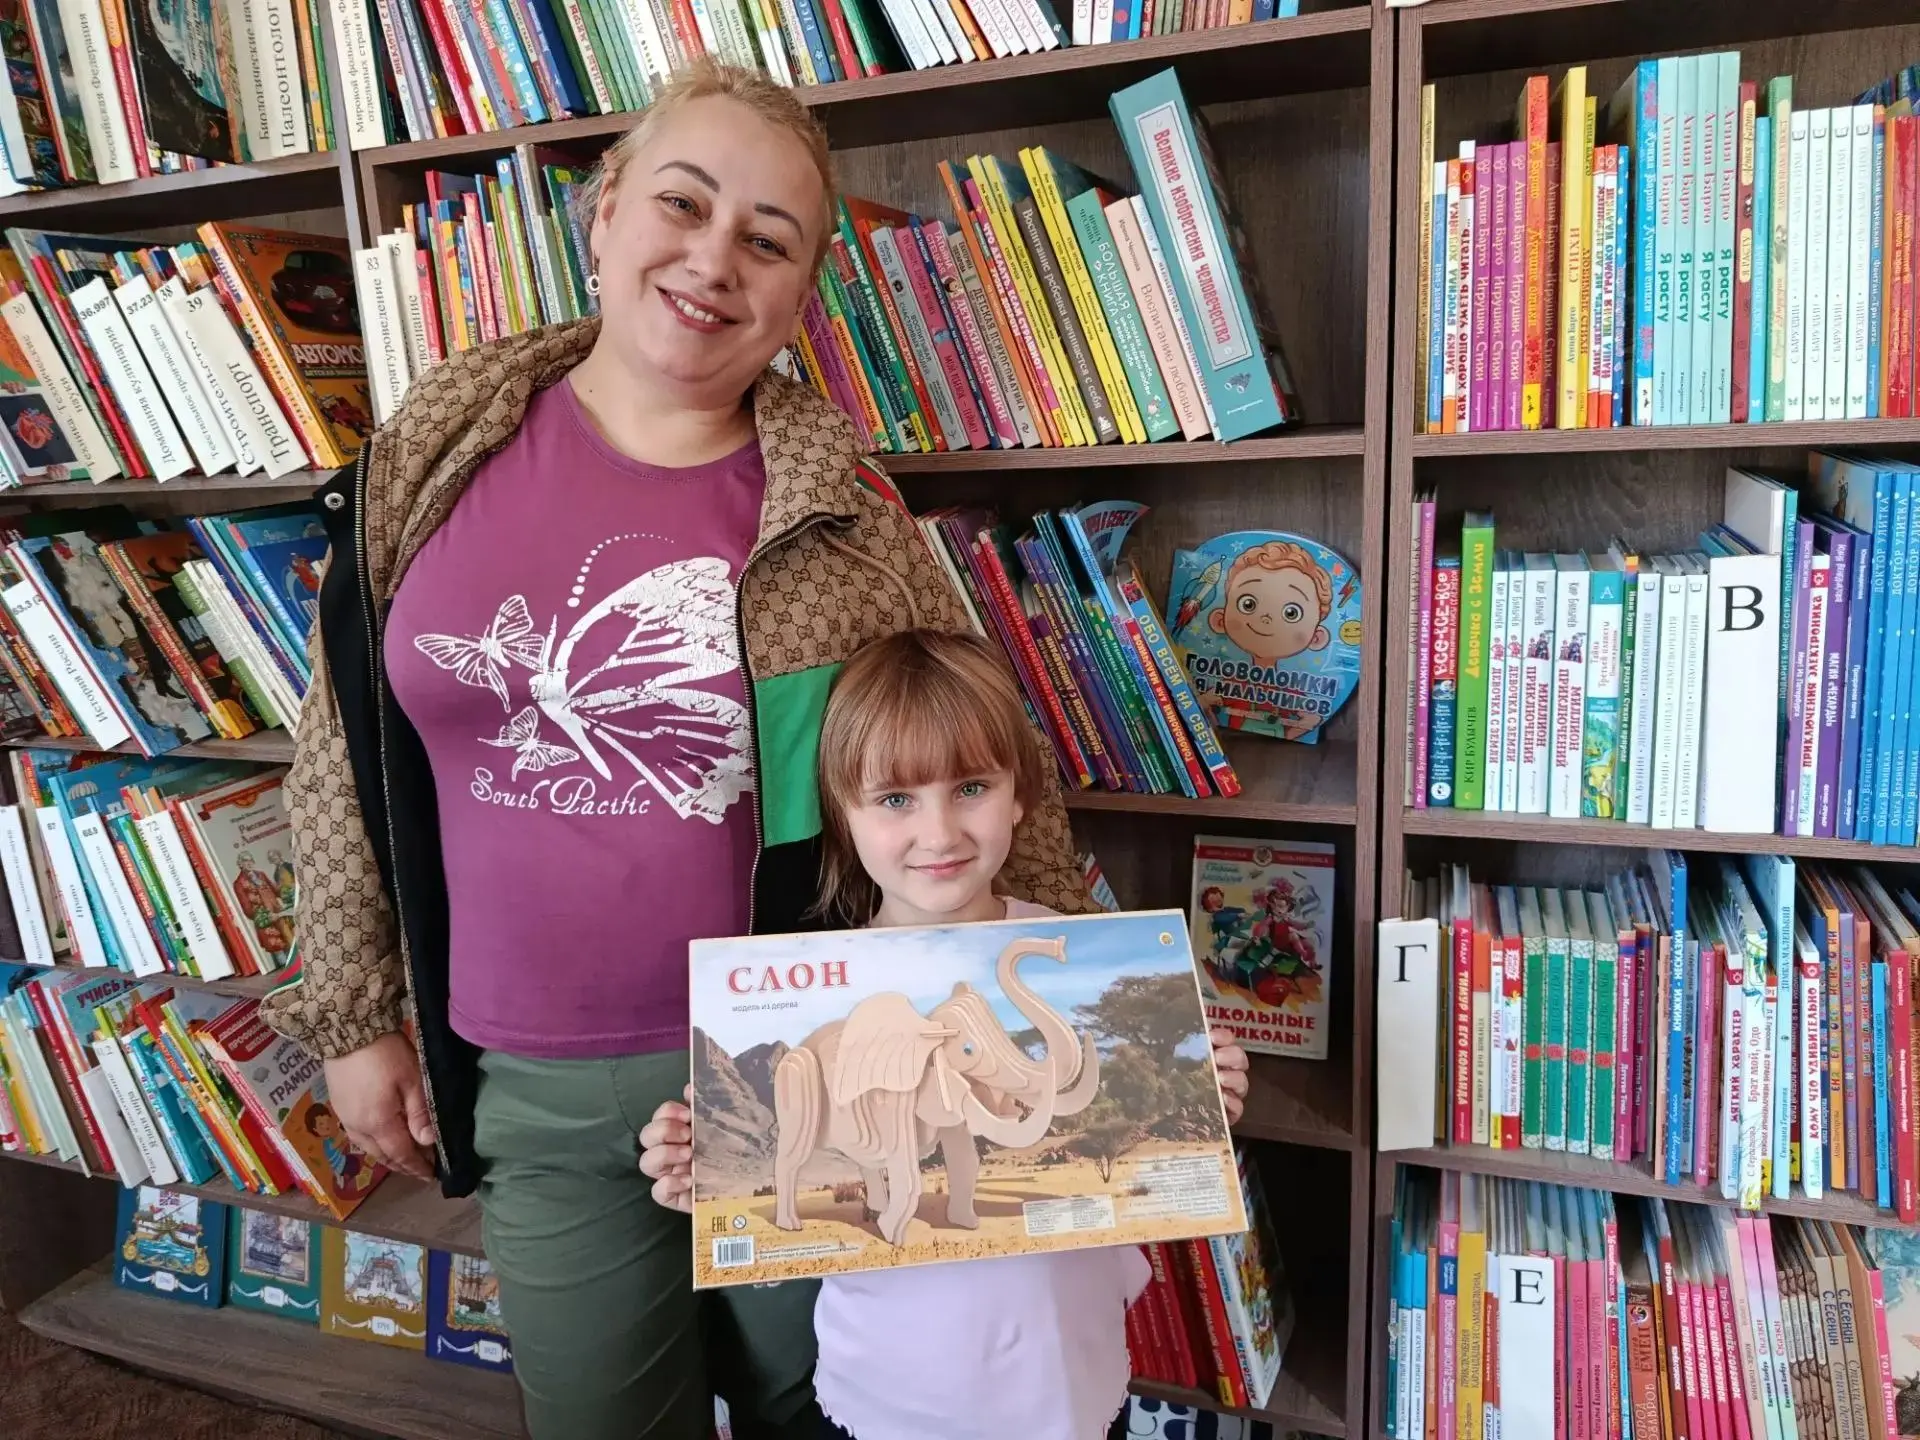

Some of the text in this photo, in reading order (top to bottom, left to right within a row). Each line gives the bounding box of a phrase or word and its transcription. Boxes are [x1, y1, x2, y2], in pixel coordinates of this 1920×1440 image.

[246, 28, 270, 140] Биологические
[356, 24, 375, 122] отдельных стран
[350, 80, 365, 133] Мировой
[1153, 128, 1233, 344] Великие изобретения человечества
[1477, 228, 1488, 266] Барто
[1493, 227, 1505, 265] Барто
[1512, 224, 1523, 264] Барто
[1567, 227, 1581, 283] СТИХИ
[1660, 253, 1672, 265] Я
[1679, 253, 1691, 266] Я
[1702, 252, 1714, 266] Я
[1720, 249, 1732, 263] Я
[1097, 242, 1131, 310] БОЛЬШАЯ
[1097, 273, 1120, 317] КНИГА
[1656, 270, 1671, 322] расту
[1676, 271, 1690, 322] расту
[1698, 271, 1712, 321] расту
[1716, 267, 1731, 318] расту
[186, 296, 204, 314] 39
[1021, 208, 1053, 272] Воспитание
[1087, 385, 1109, 409] себя
[1444, 269, 1457, 375] ЗАЙКУ БРОСИЛА
[1476, 342, 1486, 381] Стихи
[1492, 341, 1503, 380] Стихи
[1510, 340, 1522, 380] Стихи
[60, 376, 85, 414] науки
[103, 326, 177, 465] Домашняя кулинария
[225, 360, 292, 463] Транспорт
[184, 395, 220, 460] Текстильное
[1785, 545, 1795, 593] ПОДАРИТЕ
[1873, 549, 1887, 593] ДОКТОР
[1891, 498, 1907, 595] ДОКТОР УЛИТКА
[1907, 497, 1920, 594] ДОКТОР УЛИТКА
[1716, 584, 1765, 633] В
[1419, 610, 1430, 707] БУМАЖНЫЕ ГЕРОИ
[1466, 613, 1482, 678] Девочка
[1780, 631, 1790, 651] МНЕ
[46, 633, 109, 723] История России
[1139, 615, 1160, 644] ОБО
[1176, 691, 1192, 710] НА
[1189, 713, 1216, 757] СВЕТЕ
[1185, 652, 1339, 699] ГОЛОВОЛОМКИ
[1215, 679, 1333, 718] МАЛЬЧИКОВ
[1779, 654, 1789, 699] ПОДАРИТЕ
[1801, 595, 1823, 768] ПРИКЛЮЧЕНИЯ ЭЛЕКТРОНИКА
[1488, 667, 1501, 764] ДЕВОЧКА ЗЕМЛИ
[1505, 665, 1520, 762] ДЕВОЧКА ЗЕМЛИ
[1523, 666, 1536, 764] ПРИКЛЮЧЕНИЙ
[1536, 683, 1548, 748] МИЛЛИОН
[1555, 668, 1569, 768] ПРИКЛЮЧЕНИЙ
[1568, 686, 1582, 751] МИЛЛИОН
[550, 775, 650, 815] Pacific
[68, 883, 86, 918] Право
[157, 835, 206, 942] Наука. Науковедение
[727, 960, 850, 994] СЛОН
[1393, 943, 1428, 983] Г
[1672, 930, 1684, 1031] КНИЖКИ НЕСКАЗКИ
[77, 981, 120, 1008] УЧИСЬ
[732, 1001, 760, 1012] модель
[771, 1000, 798, 1010] дерева
[1457, 970, 1468, 1010] ТИМУР
[1457, 1025, 1467, 1046] ЕГО
[1457, 1050, 1468, 1105] КОМАНДА
[1748, 1027, 1760, 1103] Брат мой, Одо
[1730, 1075, 1741, 1123] МЯГКИЙ
[1808, 1080, 1819, 1139] КОМУ ЧТО
[1509, 1268, 1546, 1306] Е
[1823, 1291, 1847, 1402] С. Есенин Стихи
[1837, 1289, 1862, 1400] С. Есенин Стихи
